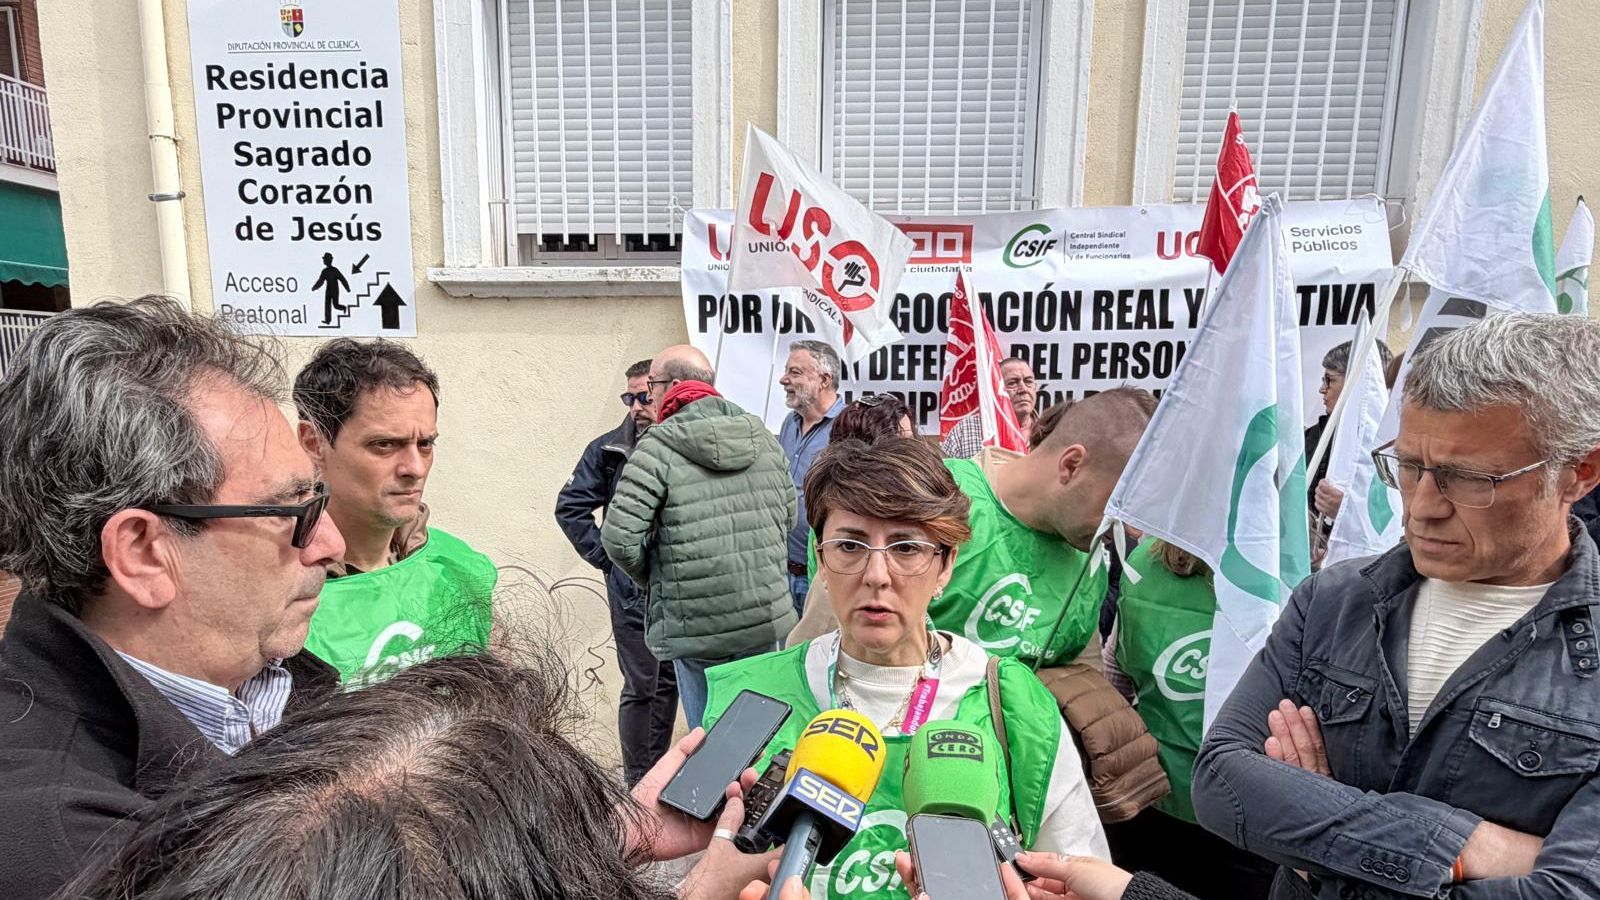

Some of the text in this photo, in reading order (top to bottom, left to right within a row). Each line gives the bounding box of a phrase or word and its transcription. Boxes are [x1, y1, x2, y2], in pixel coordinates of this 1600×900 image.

[227, 40, 360, 51] DIPUTACIÓN PROVINCIAL DE CUENCA
[205, 62, 389, 91] Residencia
[216, 101, 384, 129] Provincial
[233, 140, 372, 173] Sagrado
[237, 176, 373, 205] Corazón
[234, 213, 382, 242] de Jesús
[1097, 231, 1126, 239] Sindical
[1290, 224, 1363, 240] Servicios
[748, 239, 790, 253] UNIÓ
[1013, 239, 1058, 258] CSIF
[1070, 242, 1120, 251] Independiente
[1292, 239, 1359, 254] Públicos
[225, 272, 298, 293] Acceso
[221, 304, 307, 324] Peatonal
[698, 294, 763, 334] POR
[1093, 288, 1175, 331] REAL
[1183, 288, 1206, 330] Y
[1296, 283, 1378, 327] TIVA
[804, 717, 879, 762] SER
[934, 733, 976, 742] ONDA
[937, 744, 976, 754] CERO
[795, 775, 862, 825] SER
